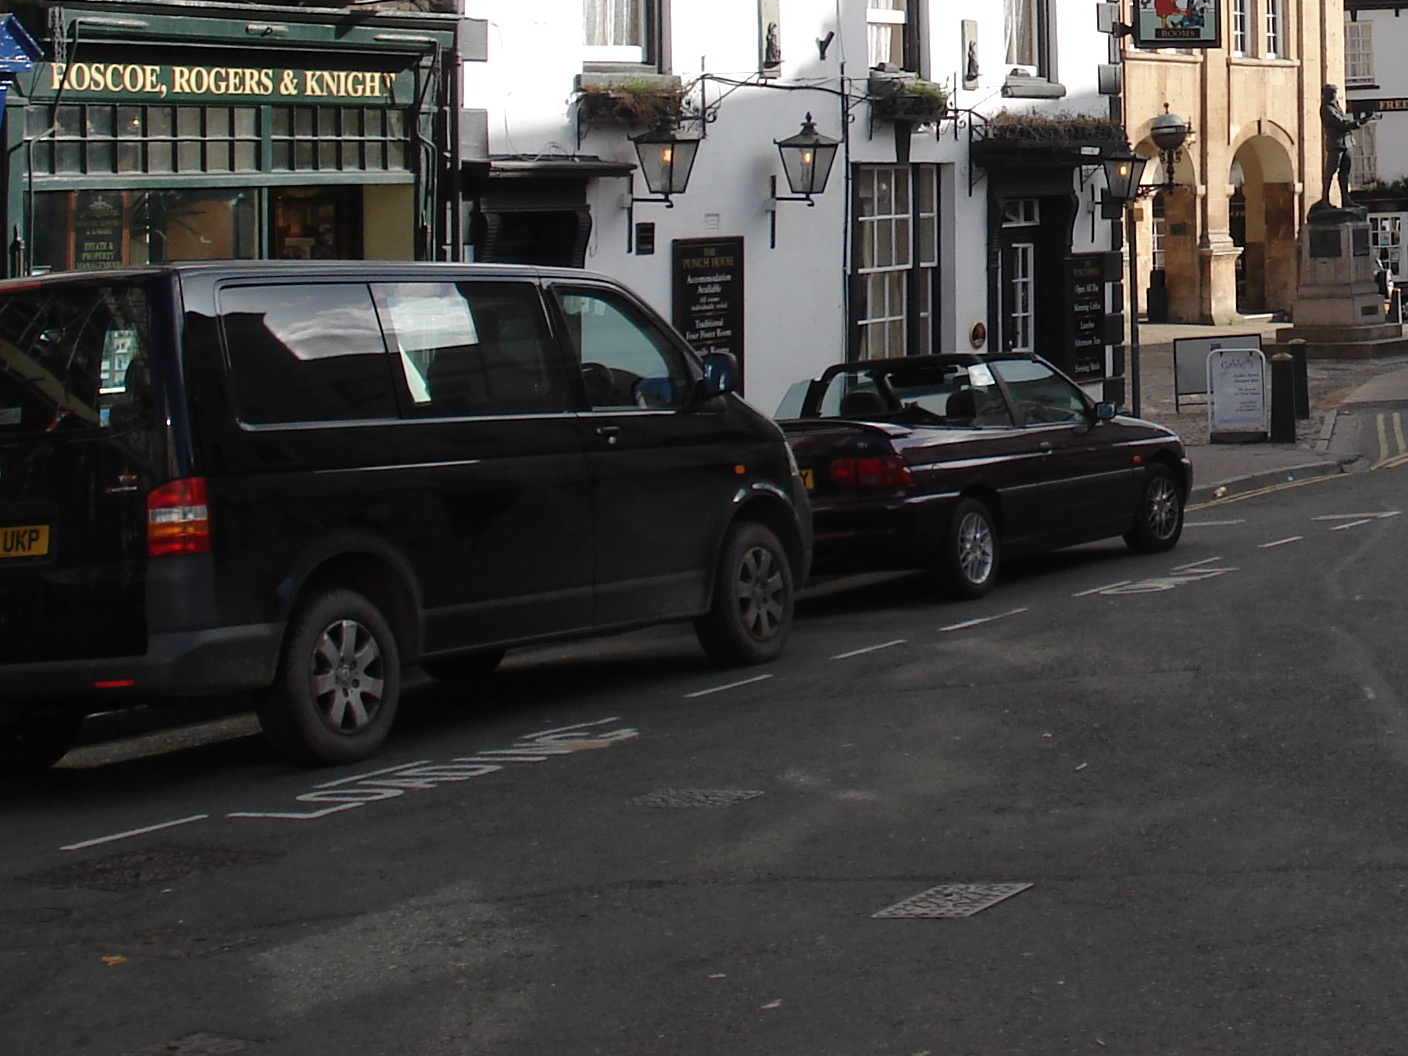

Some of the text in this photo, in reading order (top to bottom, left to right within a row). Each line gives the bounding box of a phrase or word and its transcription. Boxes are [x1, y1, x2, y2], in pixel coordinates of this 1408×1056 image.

[50, 62, 167, 100] ROSCOE,
[172, 66, 274, 95] ROGERS
[279, 69, 299, 96] &
[3, 528, 40, 553] UKP
